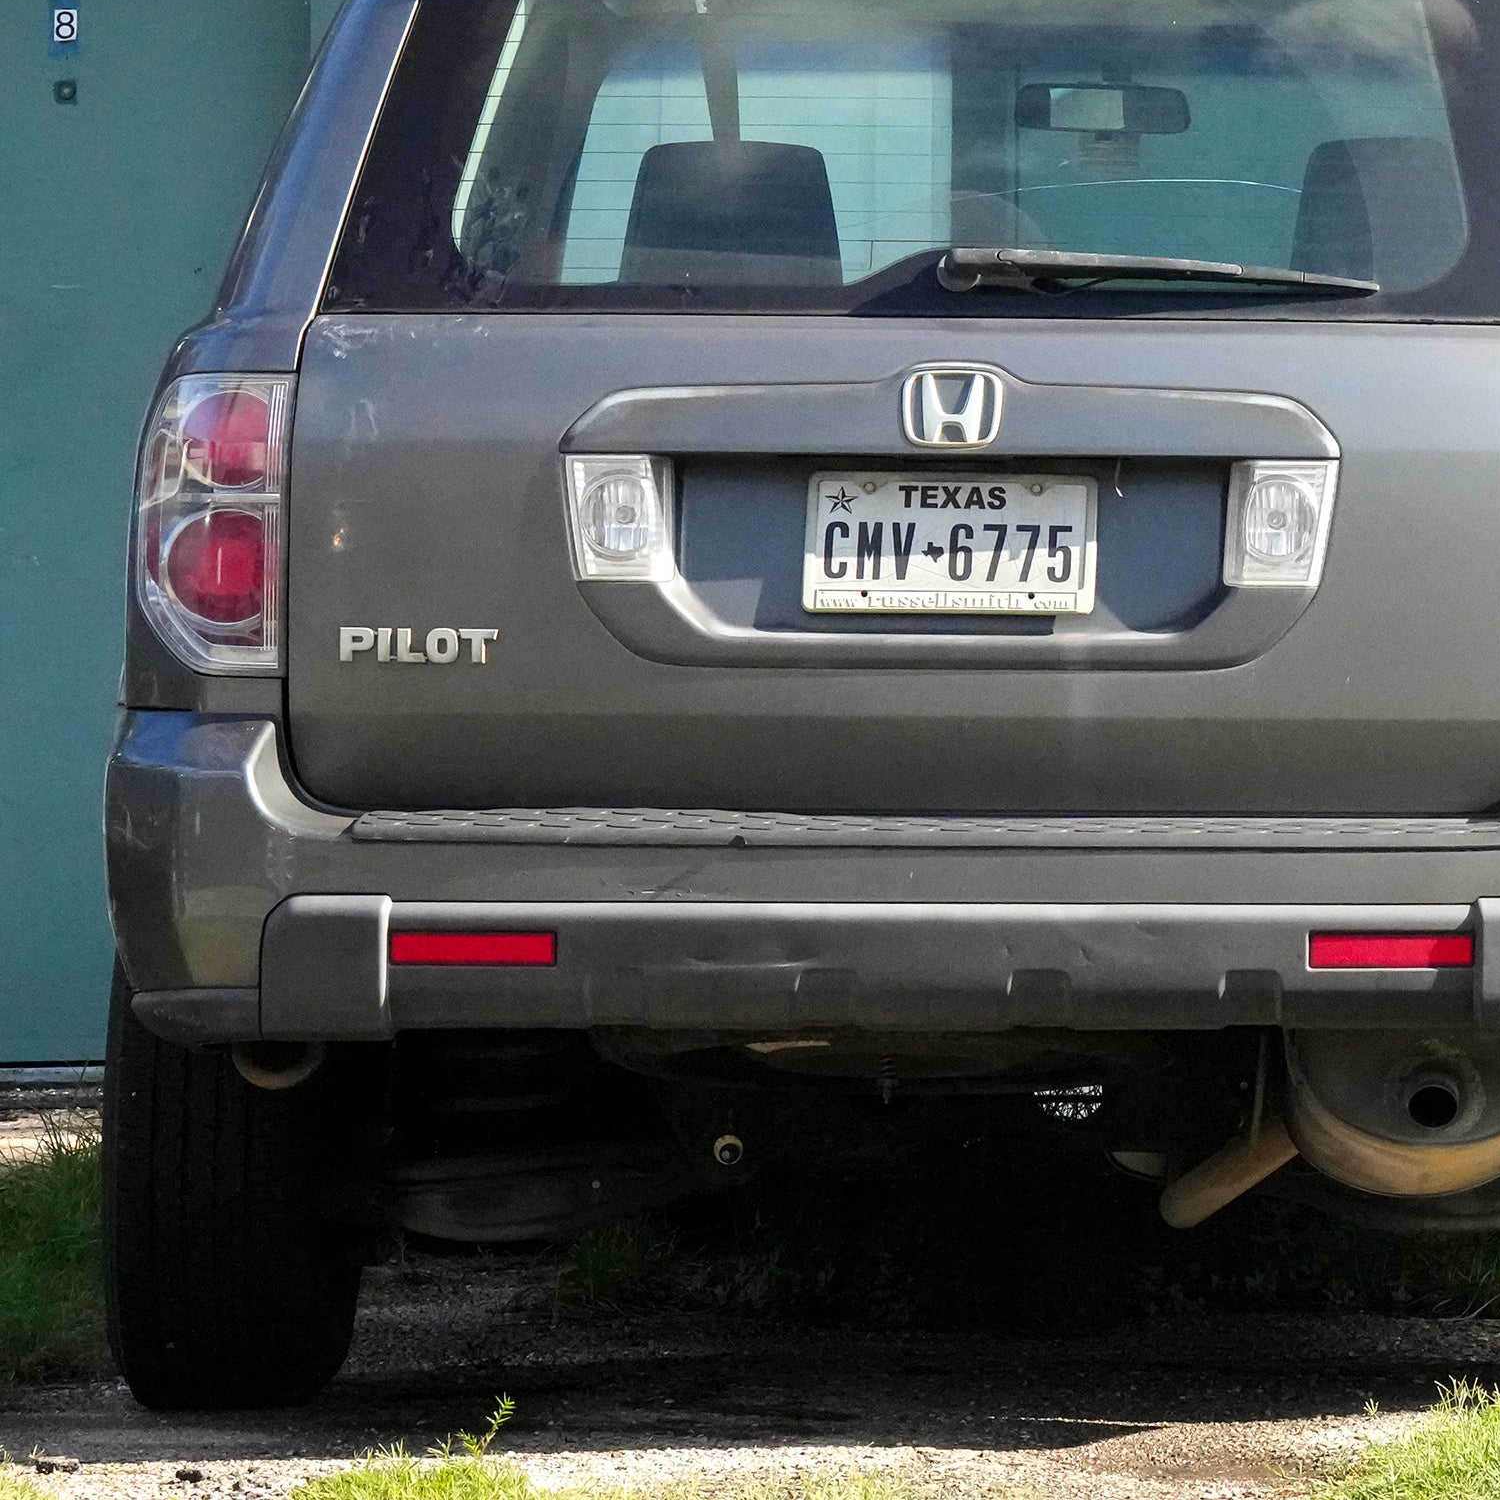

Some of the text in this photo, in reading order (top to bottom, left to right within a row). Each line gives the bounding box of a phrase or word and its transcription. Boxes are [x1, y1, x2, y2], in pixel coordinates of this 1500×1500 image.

[55, 11, 75, 39] 8
[899, 485, 1007, 510] TEXAS
[339, 626, 499, 665] PILOT
